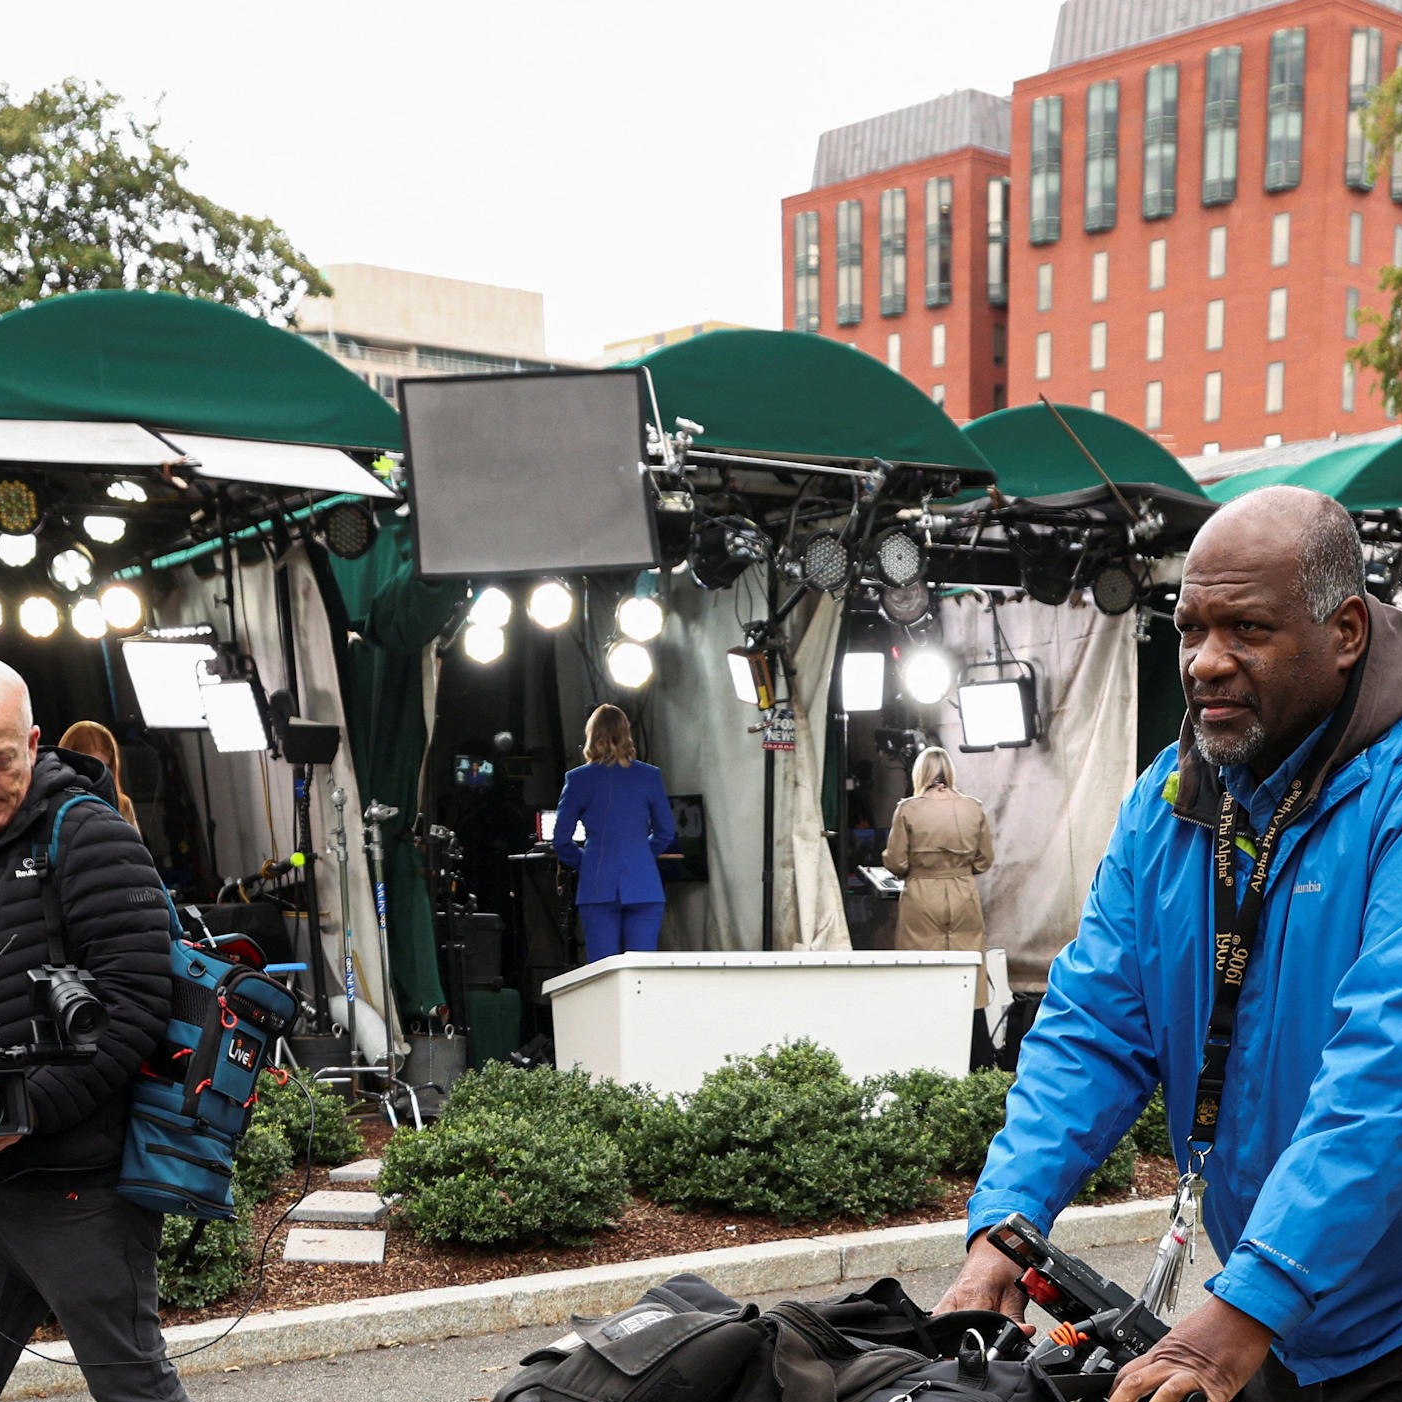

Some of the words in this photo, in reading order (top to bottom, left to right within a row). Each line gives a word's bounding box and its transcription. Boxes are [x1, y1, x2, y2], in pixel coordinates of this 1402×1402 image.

[1221, 791, 1234, 812] pha
[1219, 814, 1234, 835] Phi
[1250, 851, 1269, 892] Alpha
[1262, 827, 1277, 849] Phi
[15, 868, 37, 878] Reute
